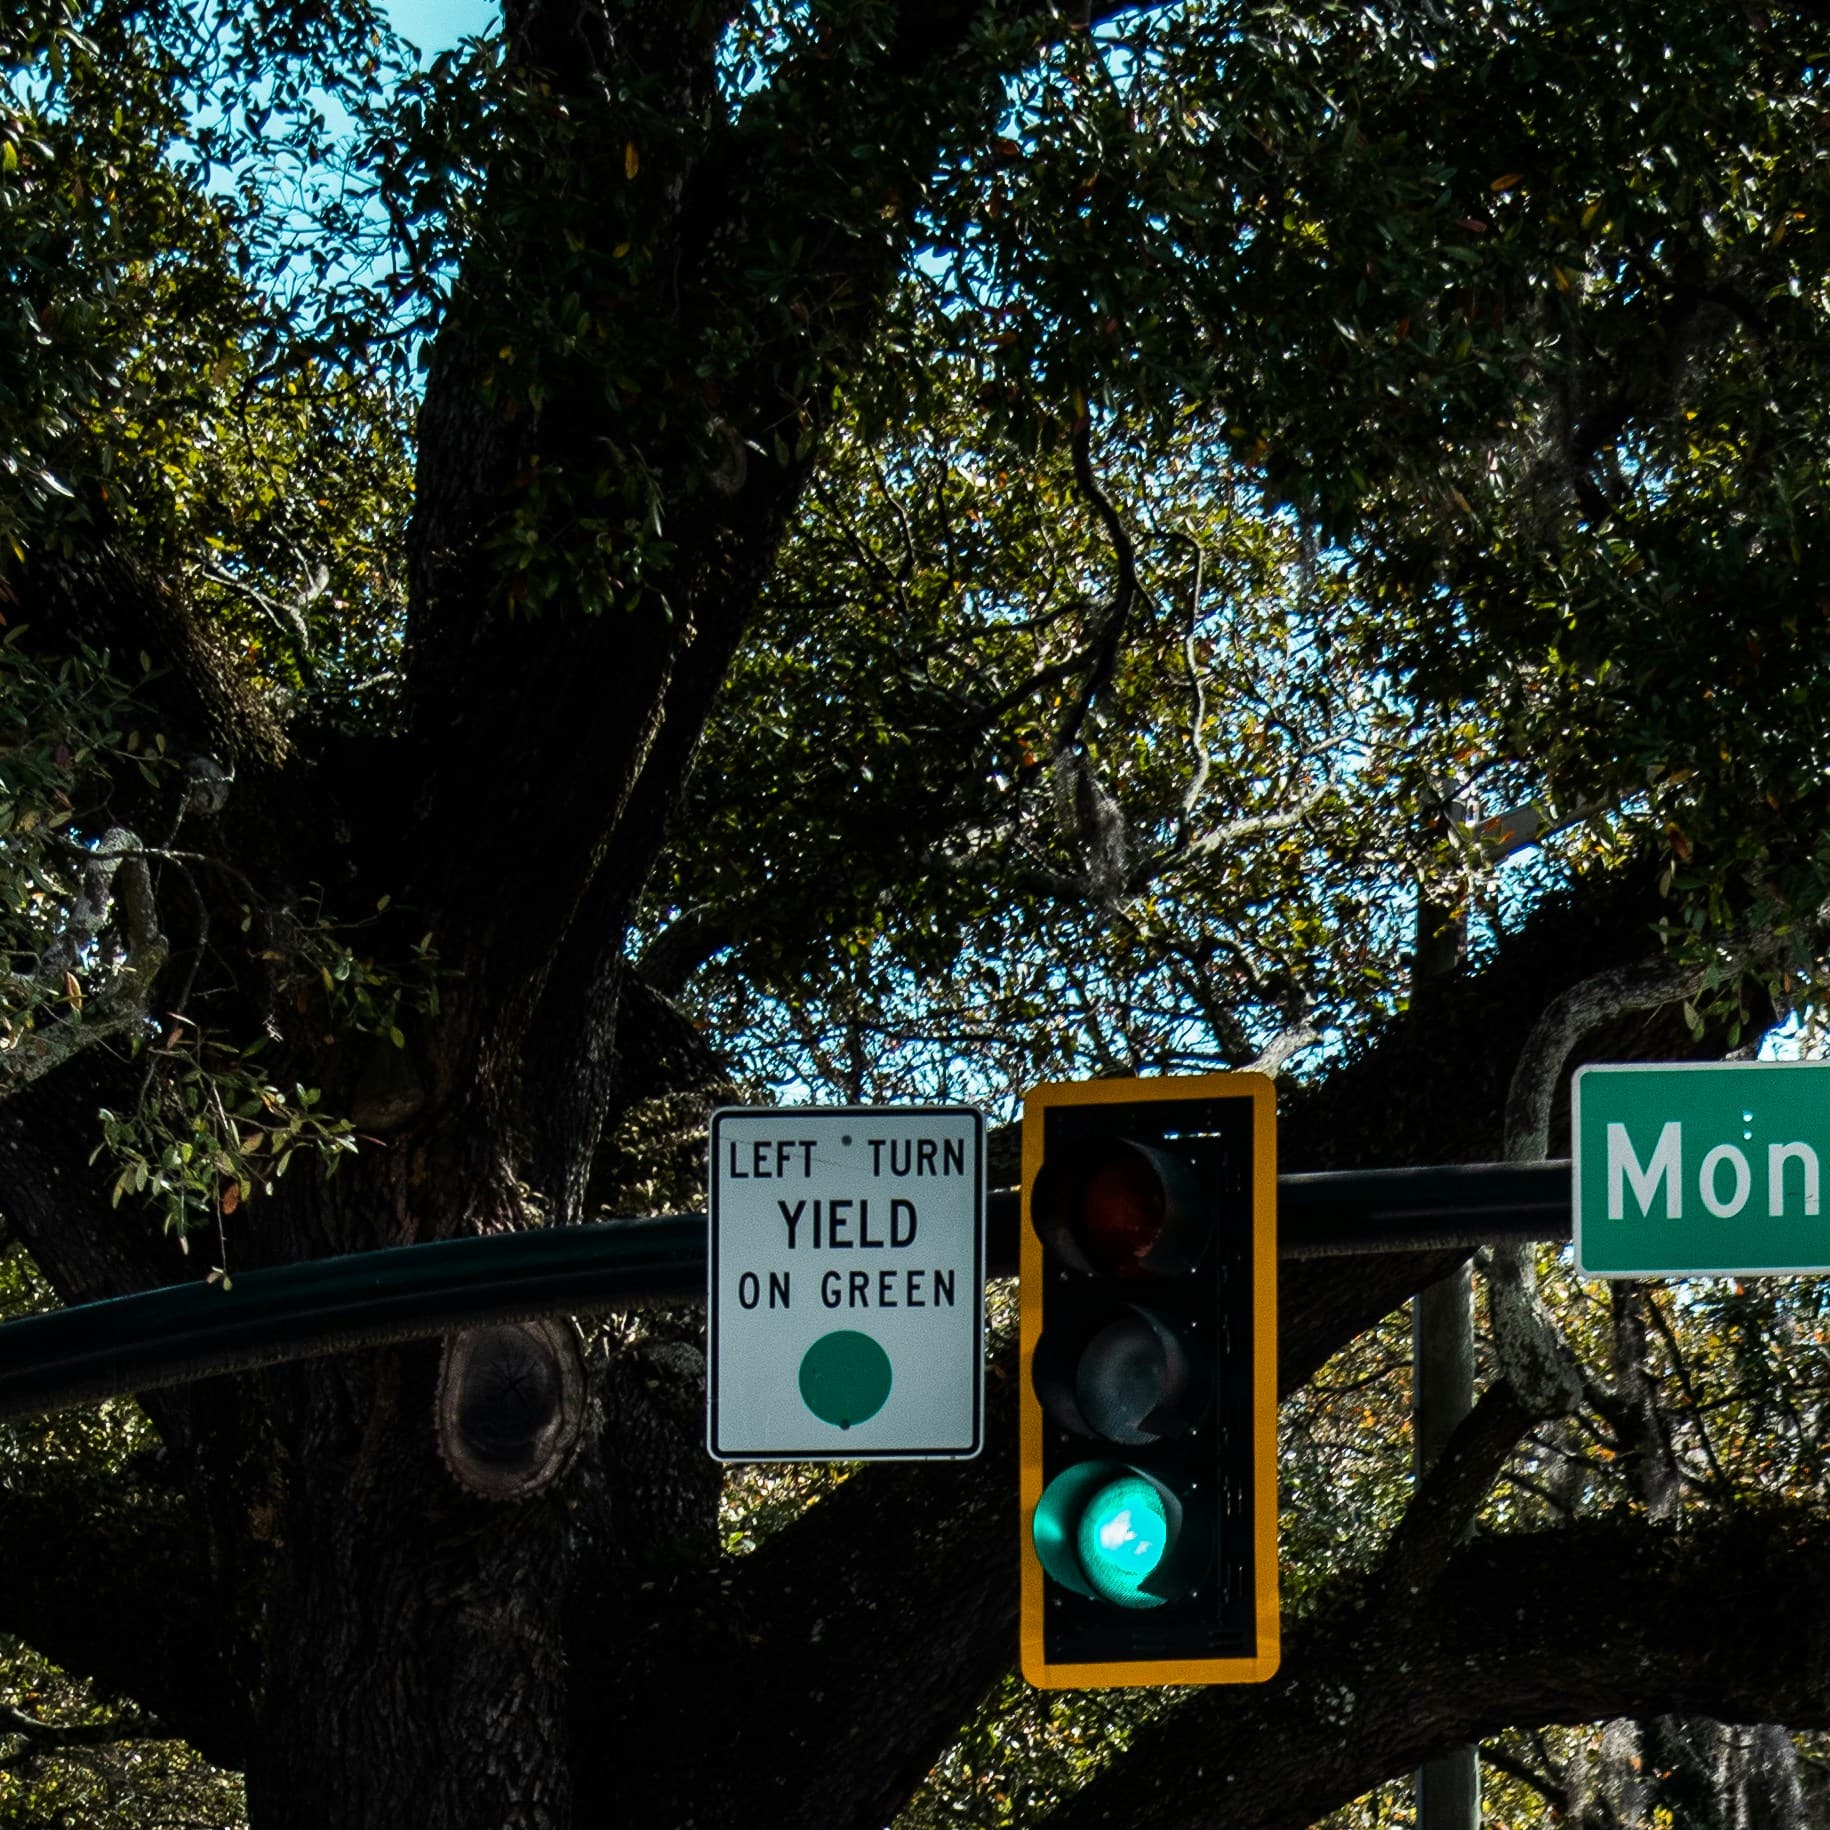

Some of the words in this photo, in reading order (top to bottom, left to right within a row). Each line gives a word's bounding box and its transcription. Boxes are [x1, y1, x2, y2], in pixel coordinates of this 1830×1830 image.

[729, 1140, 818, 1179] LEFT
[867, 1138, 966, 1177] TURN
[777, 1198, 919, 1250] YIELD
[737, 1270, 791, 1310] ON
[820, 1269, 957, 1308] GREEN
